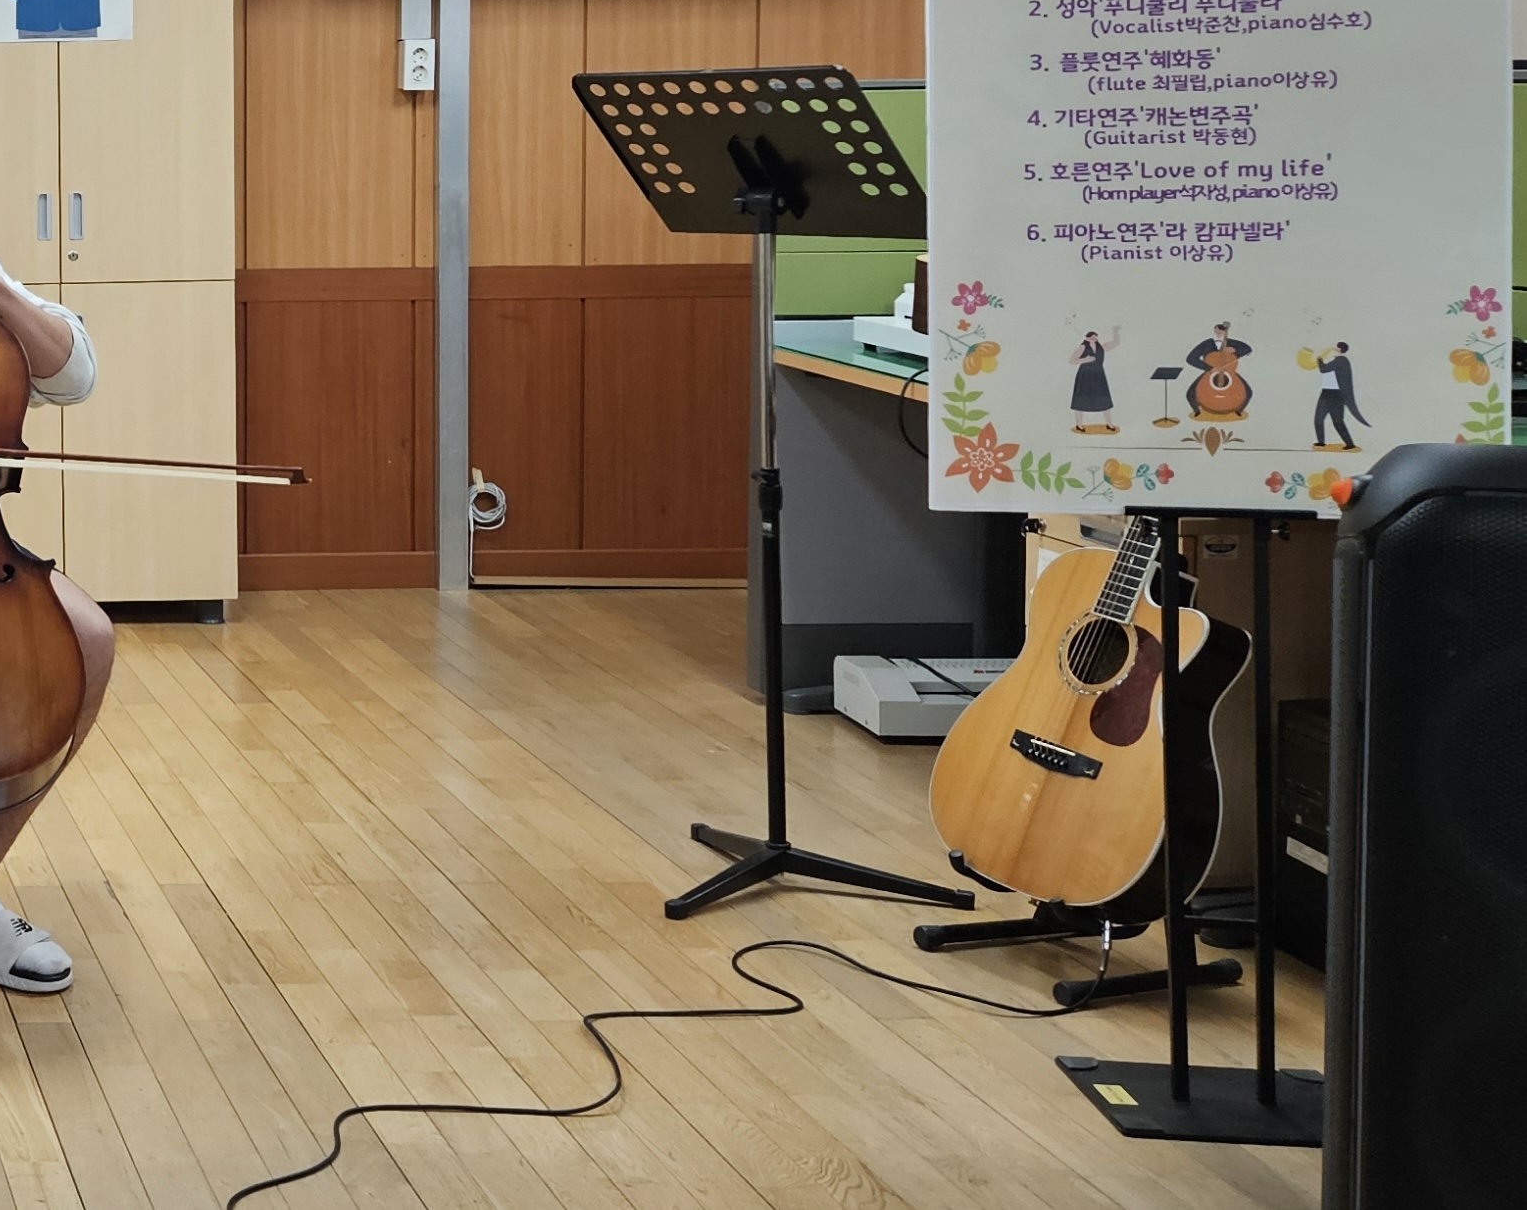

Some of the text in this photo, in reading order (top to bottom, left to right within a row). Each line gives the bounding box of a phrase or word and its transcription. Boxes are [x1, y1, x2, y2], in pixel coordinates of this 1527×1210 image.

[1028, 0, 1049, 18] 2.
[1030, 53, 1050, 72] 3.
[1087, 75, 1147, 96] (flute
[1026, 109, 1048, 128] 4.
[1084, 126, 1257, 150] (Guitarist 박동현)
[1023, 163, 1043, 182] 5.
[1203, 160, 1230, 178] of
[1237, 164, 1273, 183] my
[1027, 224, 1047, 243] 6.
[1081, 243, 1234, 264] (Pianist 이상유)
